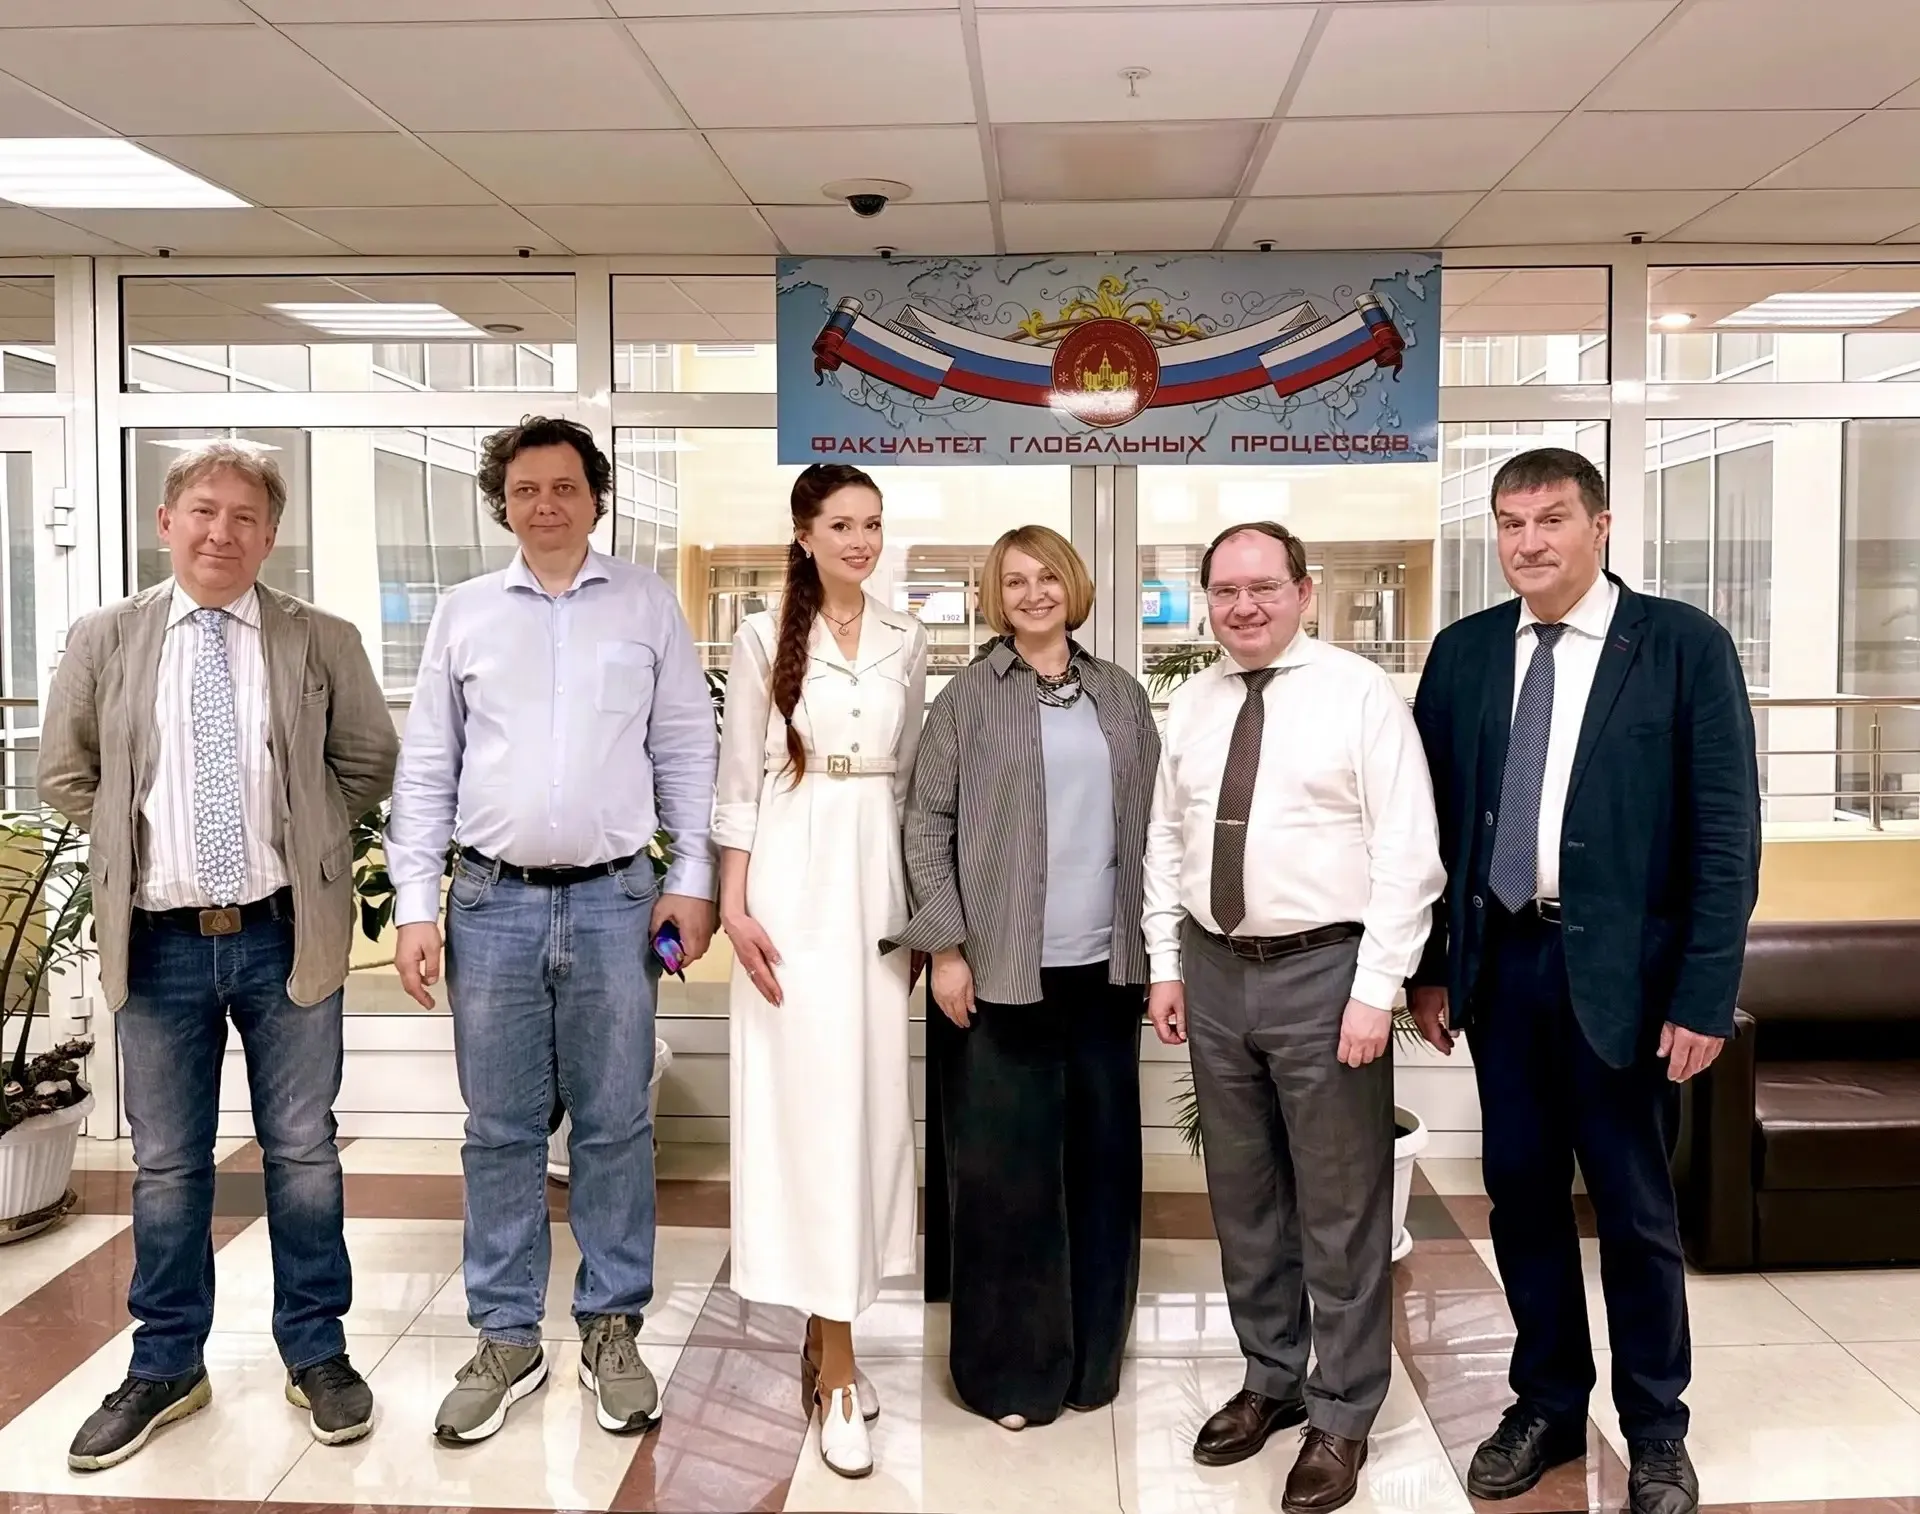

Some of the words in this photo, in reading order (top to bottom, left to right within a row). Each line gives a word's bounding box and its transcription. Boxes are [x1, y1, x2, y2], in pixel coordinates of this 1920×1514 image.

[812, 437, 987, 454] ФАКУЛЬТЕТ
[1010, 436, 1207, 454] ГЛОБАЛЬНЫХ
[1231, 436, 1410, 454] ПРОЦЕССОВ
